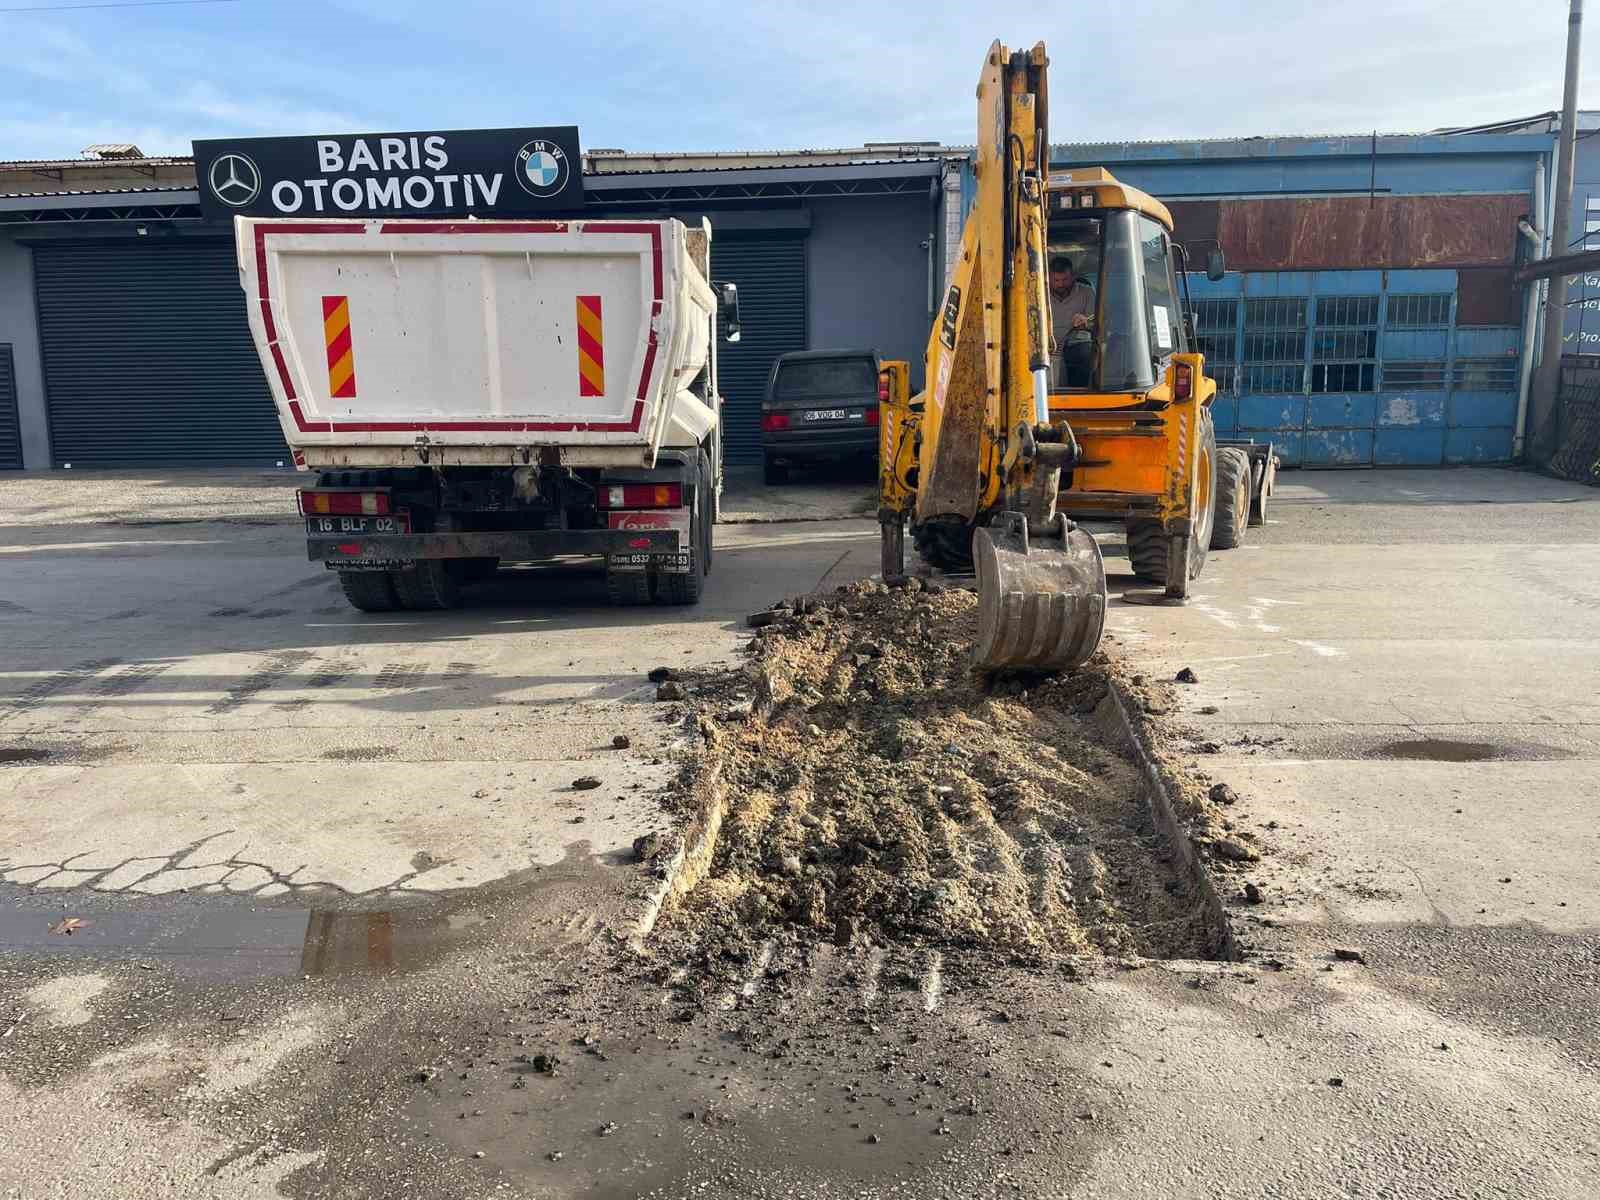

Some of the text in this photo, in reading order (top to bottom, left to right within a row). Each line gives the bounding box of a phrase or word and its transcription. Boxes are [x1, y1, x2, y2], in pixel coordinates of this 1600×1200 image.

[317, 136, 449, 171] BARIŞ
[520, 142, 563, 161] BMW
[319, 518, 394, 532] 16 BLF 02
